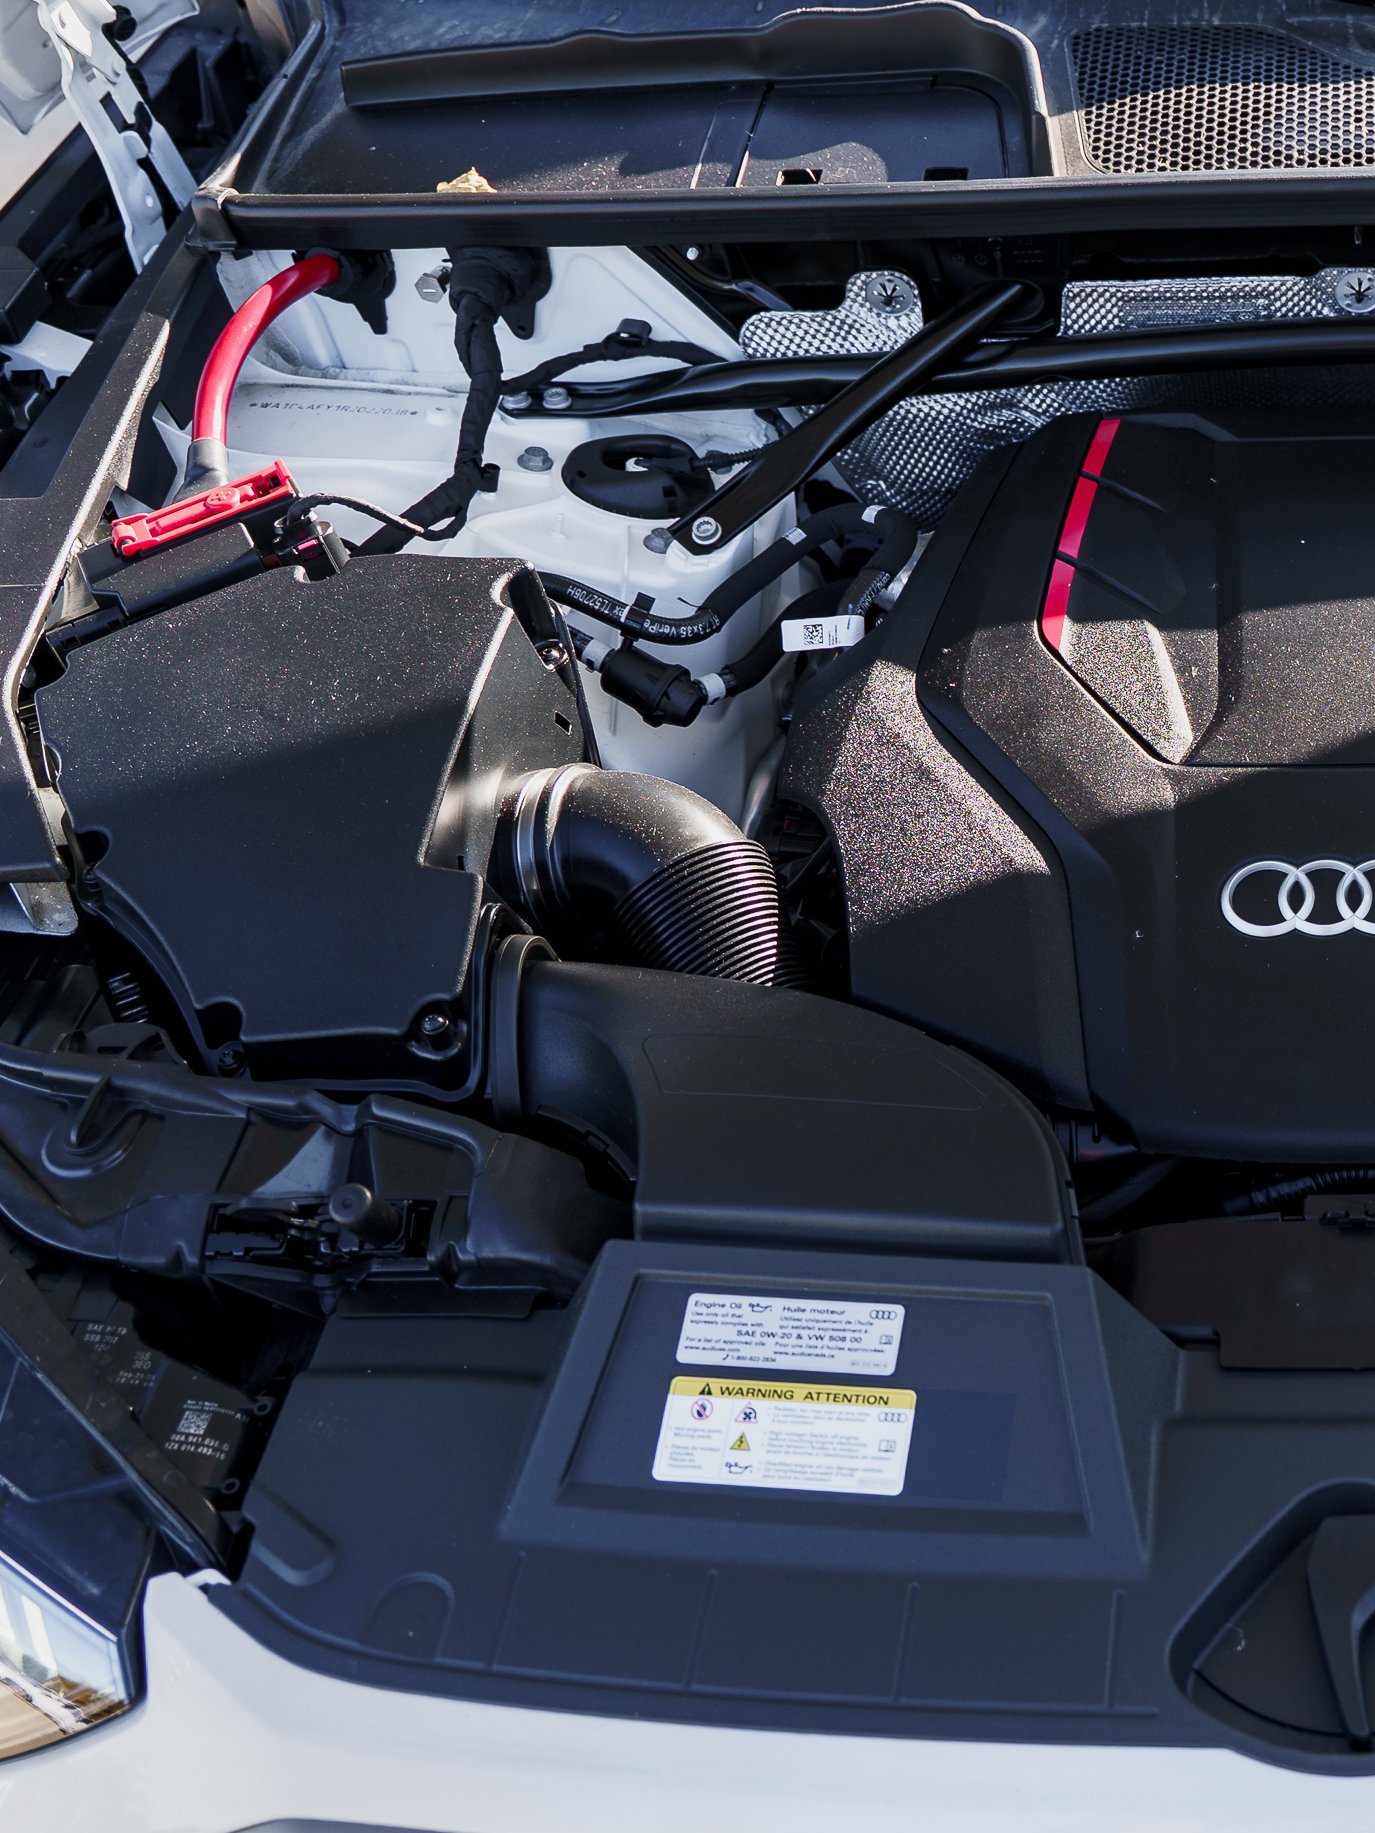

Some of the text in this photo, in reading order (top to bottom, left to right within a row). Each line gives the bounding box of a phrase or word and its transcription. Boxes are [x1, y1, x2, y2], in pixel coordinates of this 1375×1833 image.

[694, 1300, 726, 1309] Engine
[810, 1308, 846, 1316] moteur
[736, 1329, 756, 1337] SAE
[760, 1331, 792, 1339] 0W-20
[719, 1385, 890, 1406] WARNING ATTENTION
